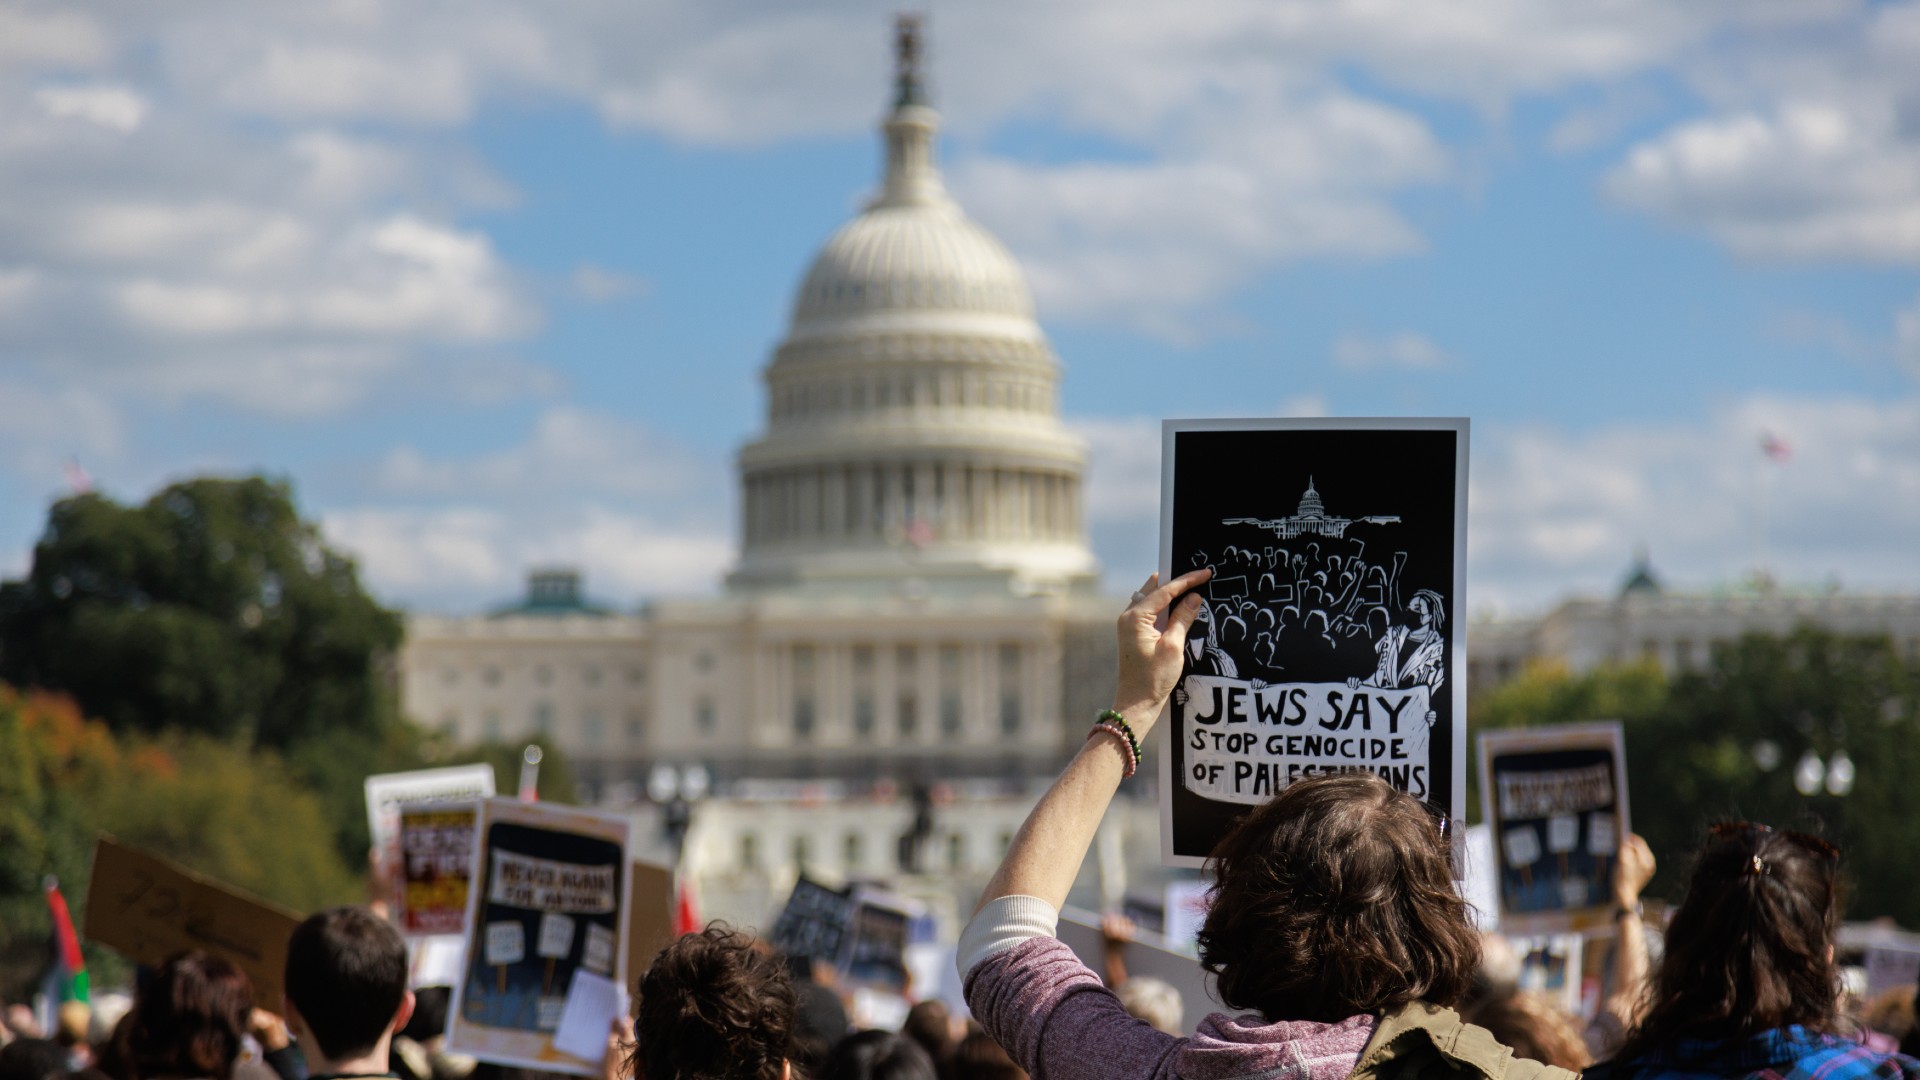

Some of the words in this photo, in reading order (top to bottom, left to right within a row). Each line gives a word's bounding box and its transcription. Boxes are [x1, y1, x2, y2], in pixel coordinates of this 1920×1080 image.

[1195, 686, 1307, 726] JEWS
[1318, 690, 1412, 733] SAY
[1191, 728, 1257, 755] STOP
[1265, 735, 1408, 759] GENOCIDE
[1192, 763, 1225, 785] OF
